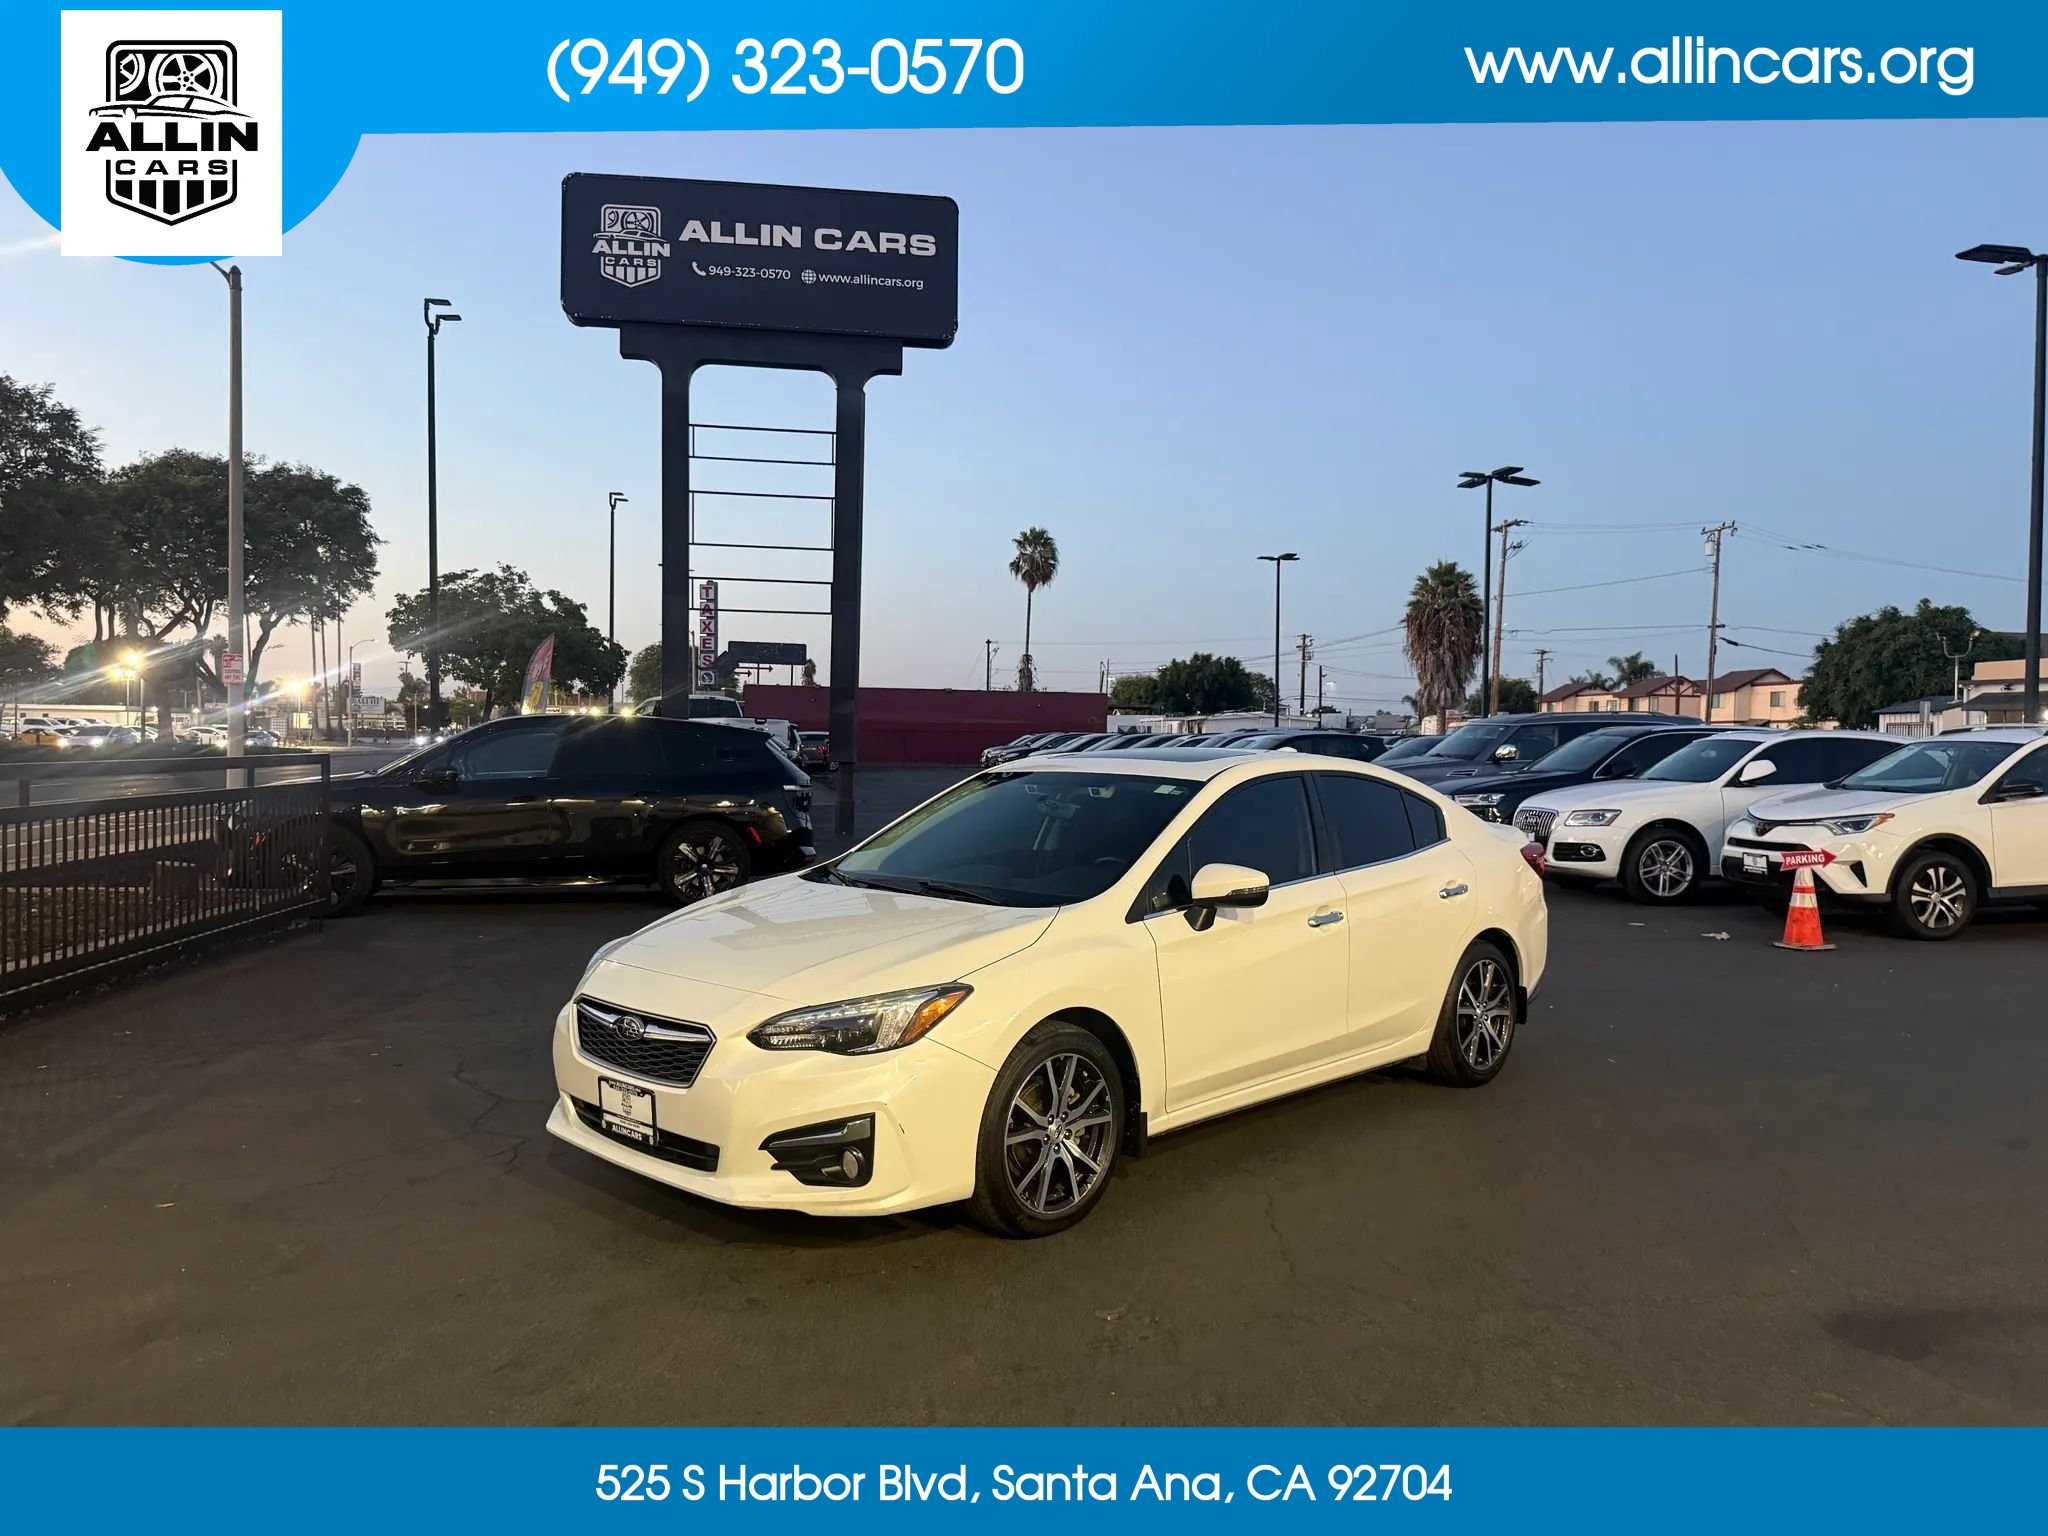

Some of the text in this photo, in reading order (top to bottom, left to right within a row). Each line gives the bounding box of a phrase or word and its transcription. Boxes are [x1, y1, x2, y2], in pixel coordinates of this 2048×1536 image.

[678, 220, 937, 257] ALLIN CARS
[592, 240, 671, 258] ALLIN
[605, 256, 657, 267] CARS
[708, 265, 791, 280] 949-323-0570
[818, 273, 924, 291] www.allincars.org
[701, 586, 714, 667] TAXES
[1785, 853, 1825, 866] PARKING
